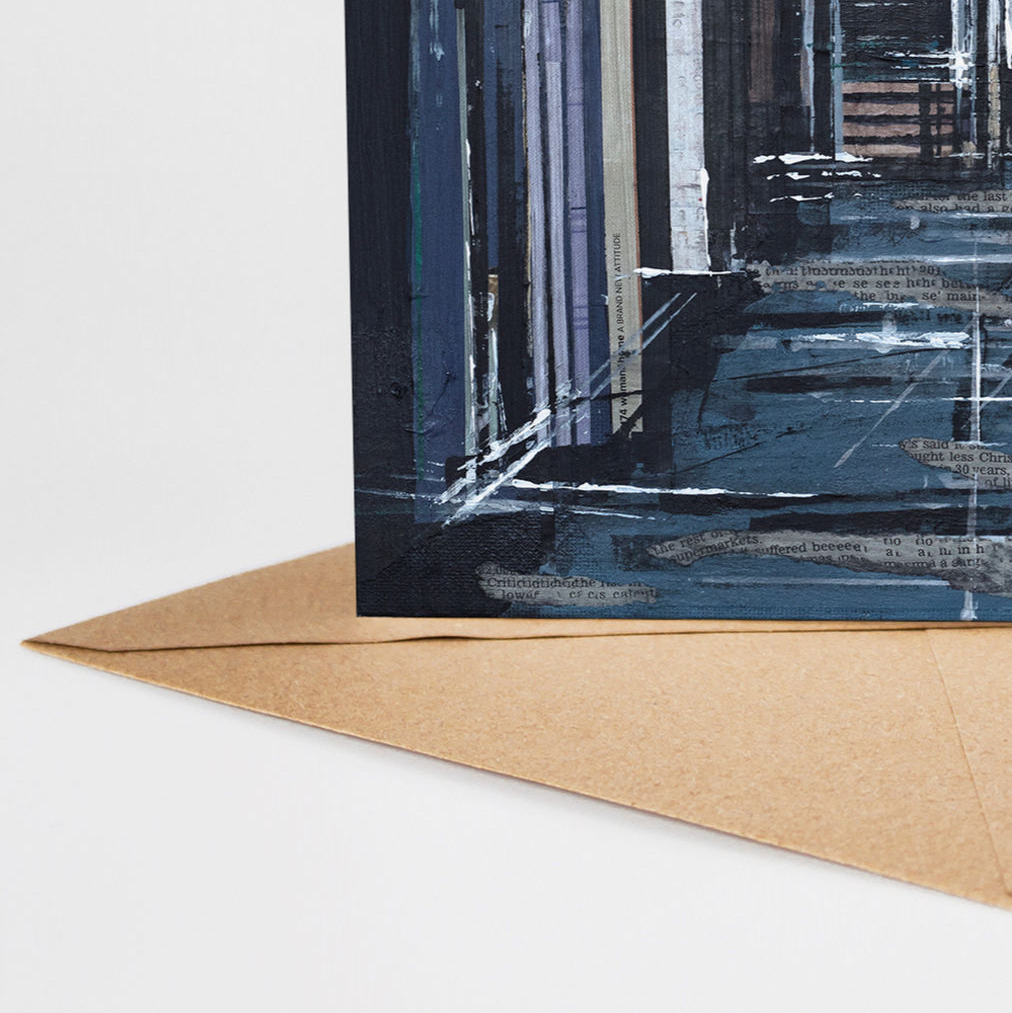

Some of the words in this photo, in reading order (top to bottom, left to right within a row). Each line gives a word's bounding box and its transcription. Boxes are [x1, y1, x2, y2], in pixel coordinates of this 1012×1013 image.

[984, 191, 1007, 201] last
[612, 233, 621, 273] ATTITUDE
[615, 296, 624, 324] BRAND
[923, 440, 949, 450] said
[949, 451, 974, 462] less
[955, 464, 969, 475] 30
[680, 533, 706, 548] rest
